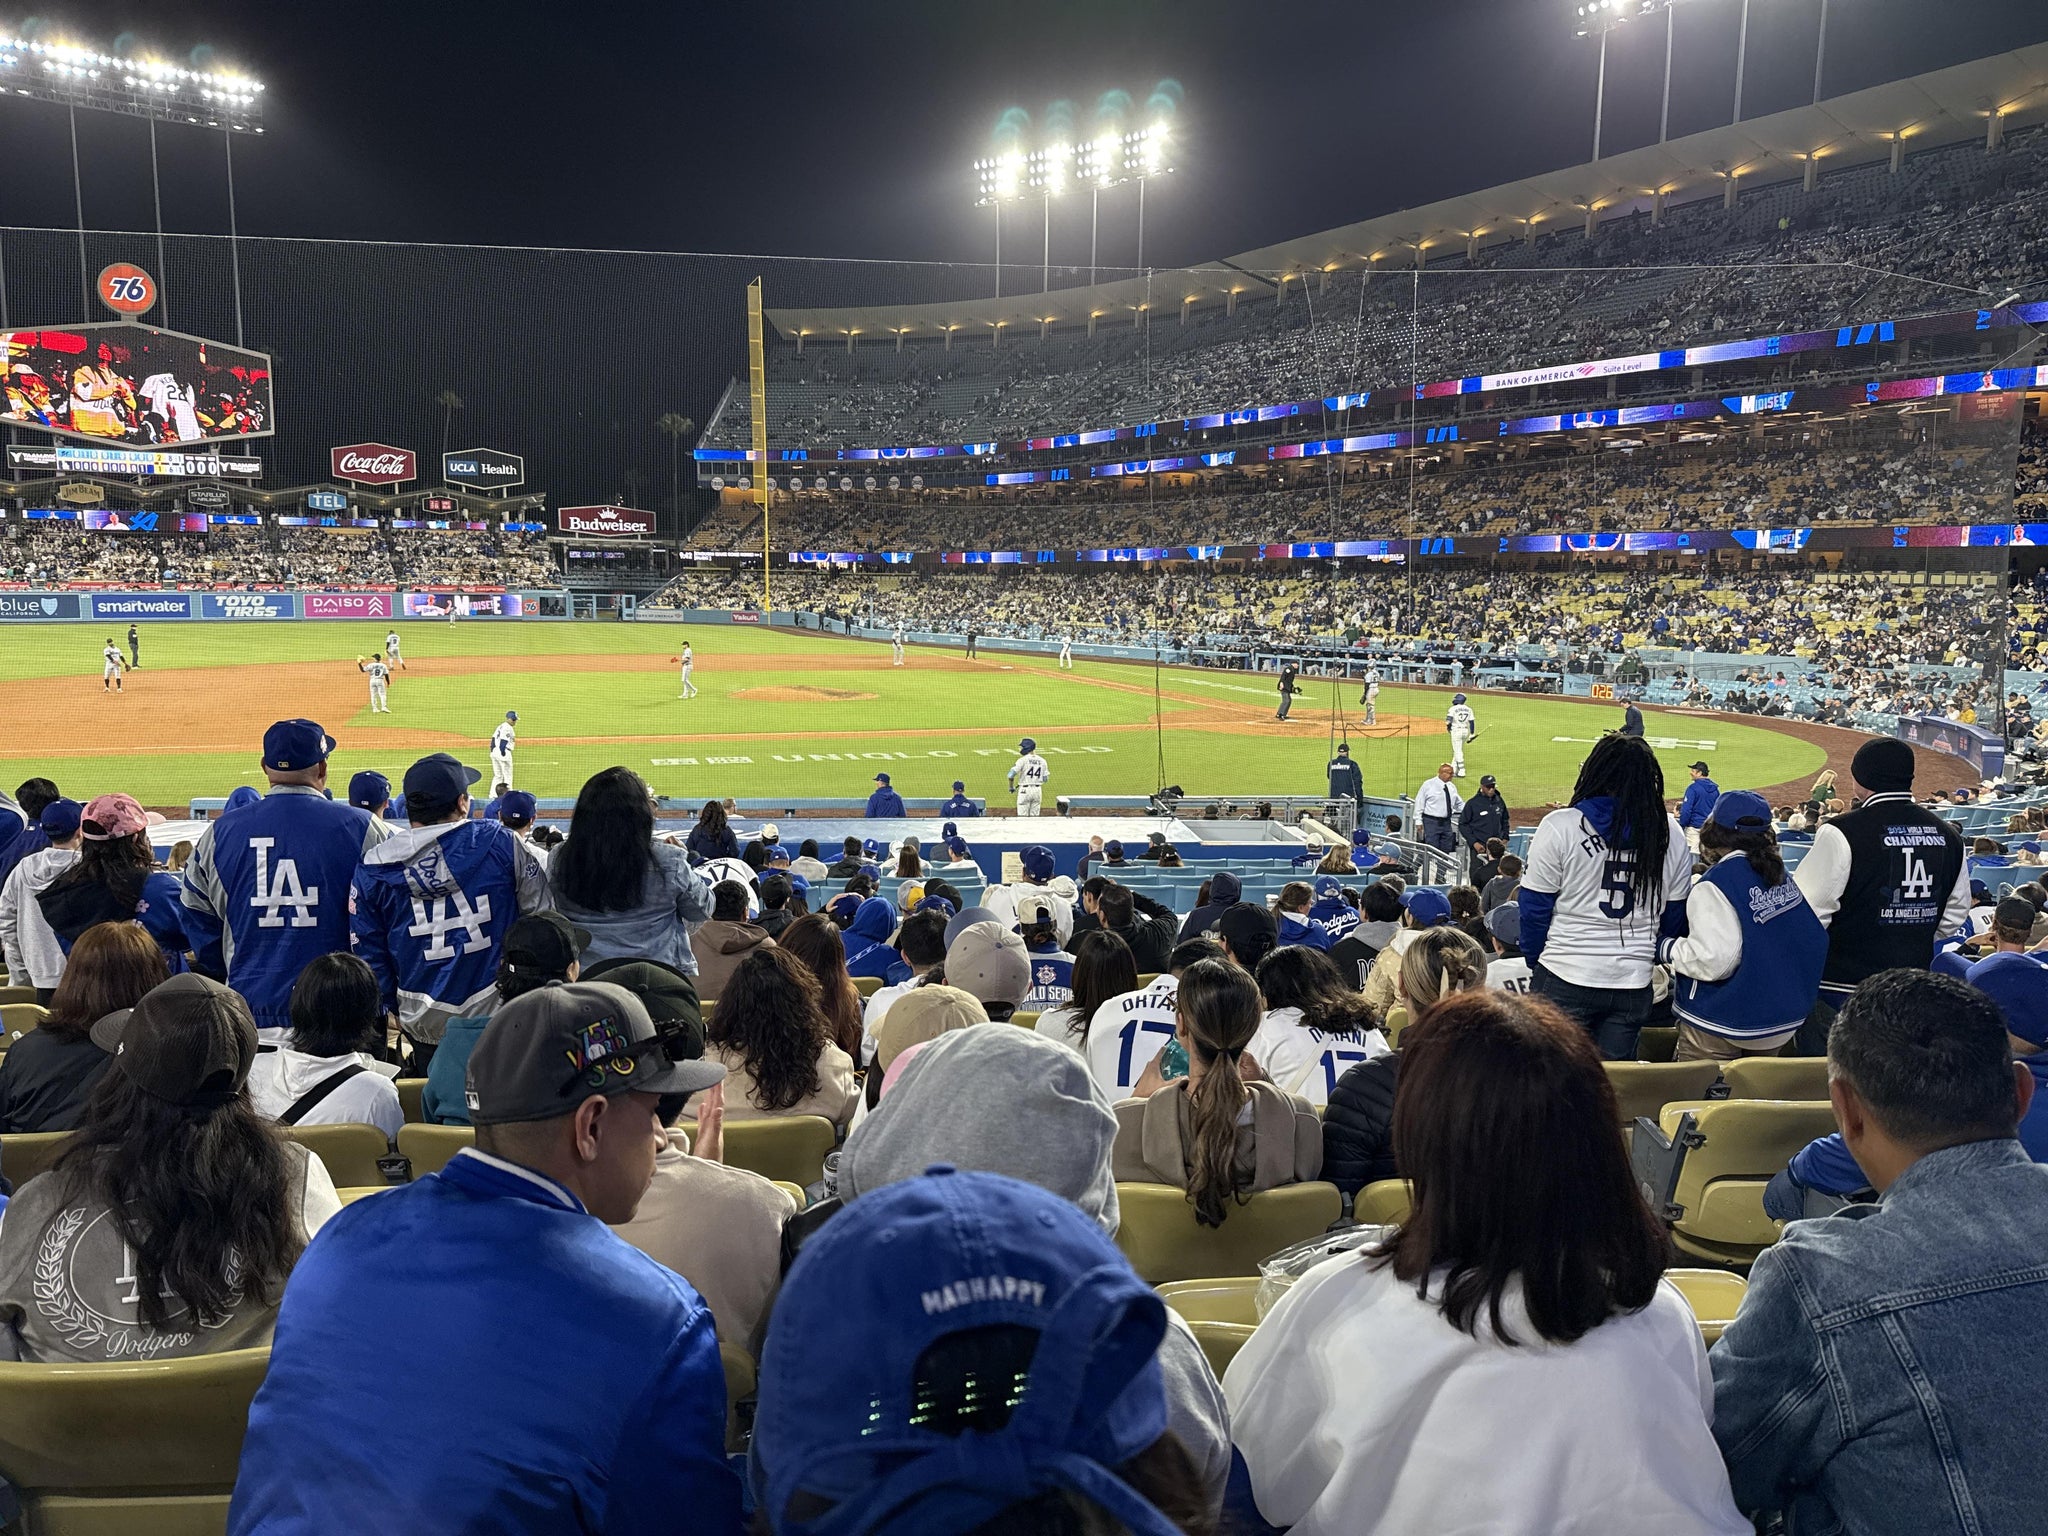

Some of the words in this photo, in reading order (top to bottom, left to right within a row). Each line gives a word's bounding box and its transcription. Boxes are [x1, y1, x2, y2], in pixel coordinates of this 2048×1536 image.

[109, 277, 146, 302] 76
[1602, 364, 1620, 374] Suite
[1622, 361, 1642, 372] Level
[1496, 377, 1520, 388] BANK
[1522, 376, 1533, 384] OF
[1534, 371, 1575, 383] AMERICA
[340, 451, 407, 476] Coca-Cola
[450, 462, 476, 473] UCLA
[481, 463, 517, 476] Health
[64, 487, 78, 499] JIM
[78, 484, 101, 498] BEAM
[191, 491, 227, 499] STARLUX
[313, 495, 342, 508] TEL
[568, 516, 648, 533] Budweiser
[0, 598, 39, 611] blue
[98, 599, 184, 614] smartwater
[215, 595, 264, 607] TOYO
[313, 597, 364, 608] DAISO
[524, 603, 537, 611] 76
[224, 606, 274, 617] TIRES
[733, 613, 759, 622] Yakult
[1592, 684, 1613, 699] 026
[772, 750, 959, 763] UNIQLO
[1026, 766, 1042, 779] 44
[1883, 835, 1946, 847] CHAMPIONS
[707, 862, 730, 883] 17
[1901, 847, 1933, 898] LA
[250, 837, 319, 927] LA
[1599, 860, 1638, 919] 5
[1881, 908, 1894, 918] LOS
[408, 890, 492, 961] LA
[1311, 911, 1360, 936] Dodgers
[1122, 993, 1177, 1013] OHTA
[1117, 1019, 1177, 1088] 17
[1319, 1050, 1368, 1102] 17
[920, 1274, 1047, 1316] MADHAPPY
[105, 1327, 194, 1361] Dodgers
